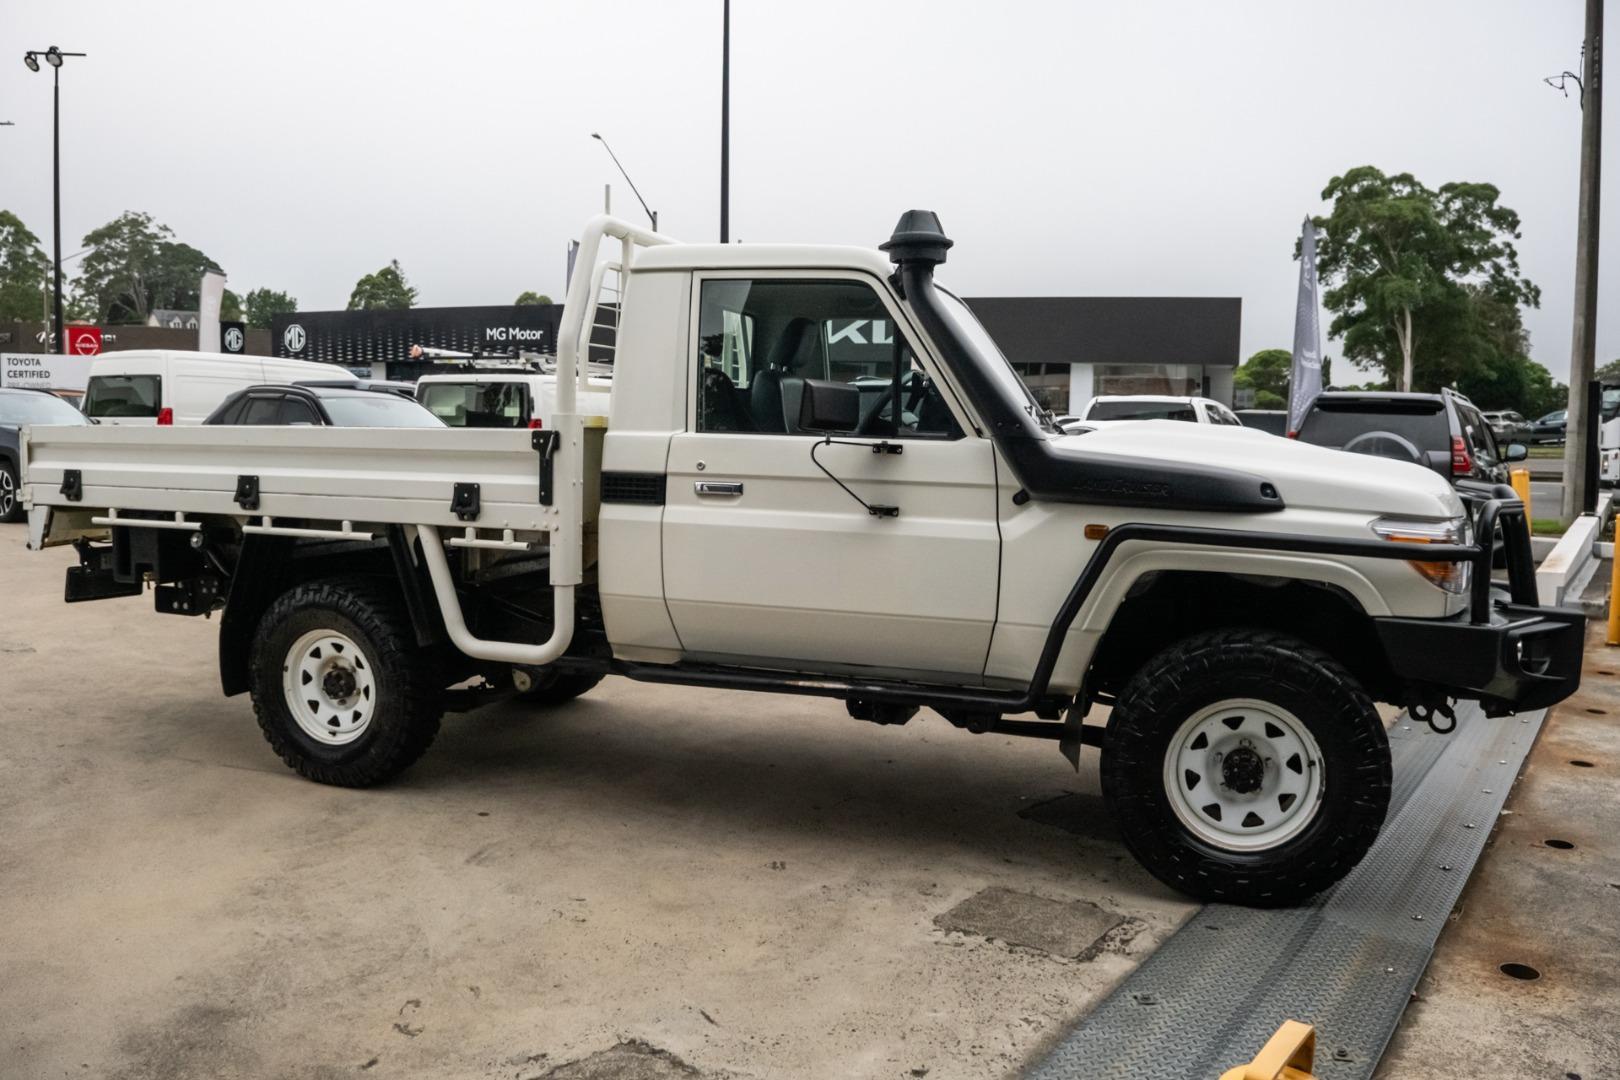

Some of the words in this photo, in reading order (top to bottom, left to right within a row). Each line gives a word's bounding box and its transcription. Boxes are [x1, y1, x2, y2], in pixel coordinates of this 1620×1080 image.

[226, 329, 242, 350] MG
[286, 325, 304, 350] MG
[486, 327, 507, 340] MG
[509, 327, 544, 340] Motor
[826, 320, 894, 344] KI
[7, 358, 41, 366] TOYOTA
[7, 370, 51, 379] CERTIFIED
